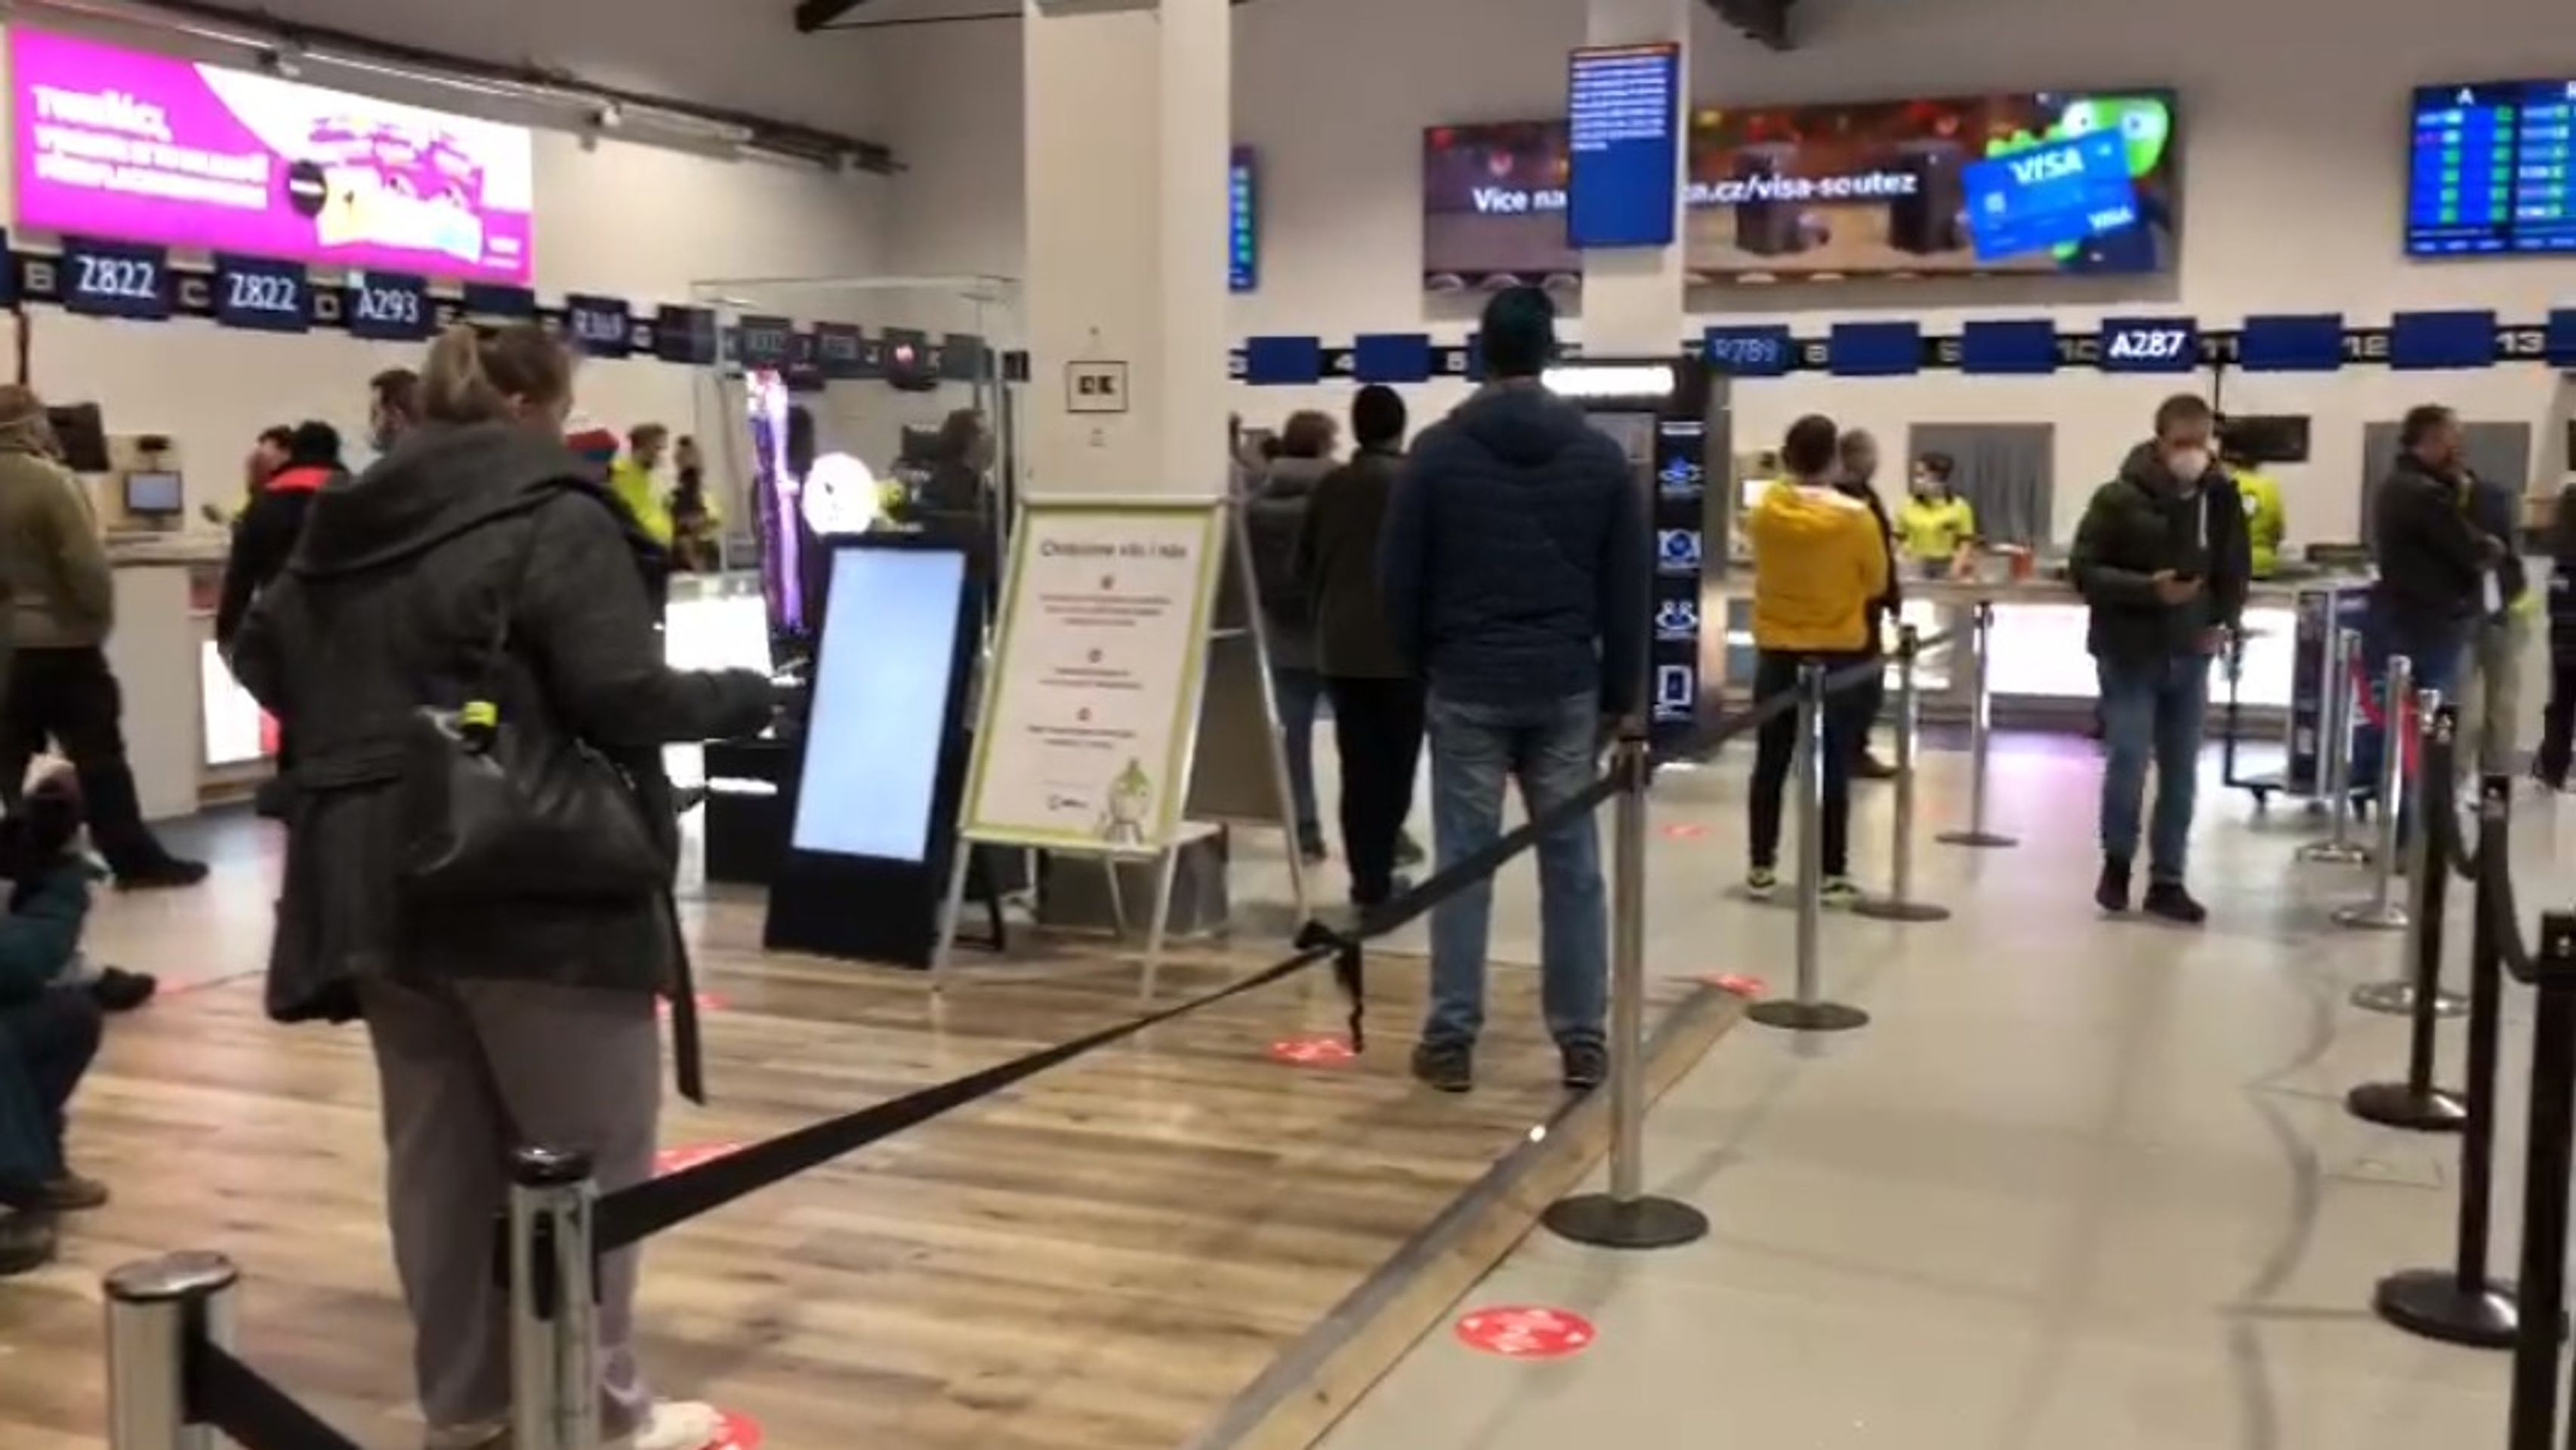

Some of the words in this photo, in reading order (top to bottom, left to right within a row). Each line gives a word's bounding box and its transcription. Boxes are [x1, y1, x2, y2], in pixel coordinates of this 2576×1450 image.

[2007, 147, 2085, 186] VISA
[24, 263, 55, 292] B
[75, 255, 156, 299] Z822
[180, 279, 210, 307] C
[228, 273, 298, 311] Z822
[358, 287, 419, 323] A293
[2109, 330, 2186, 359] A287
[2494, 332, 2544, 353] 13
